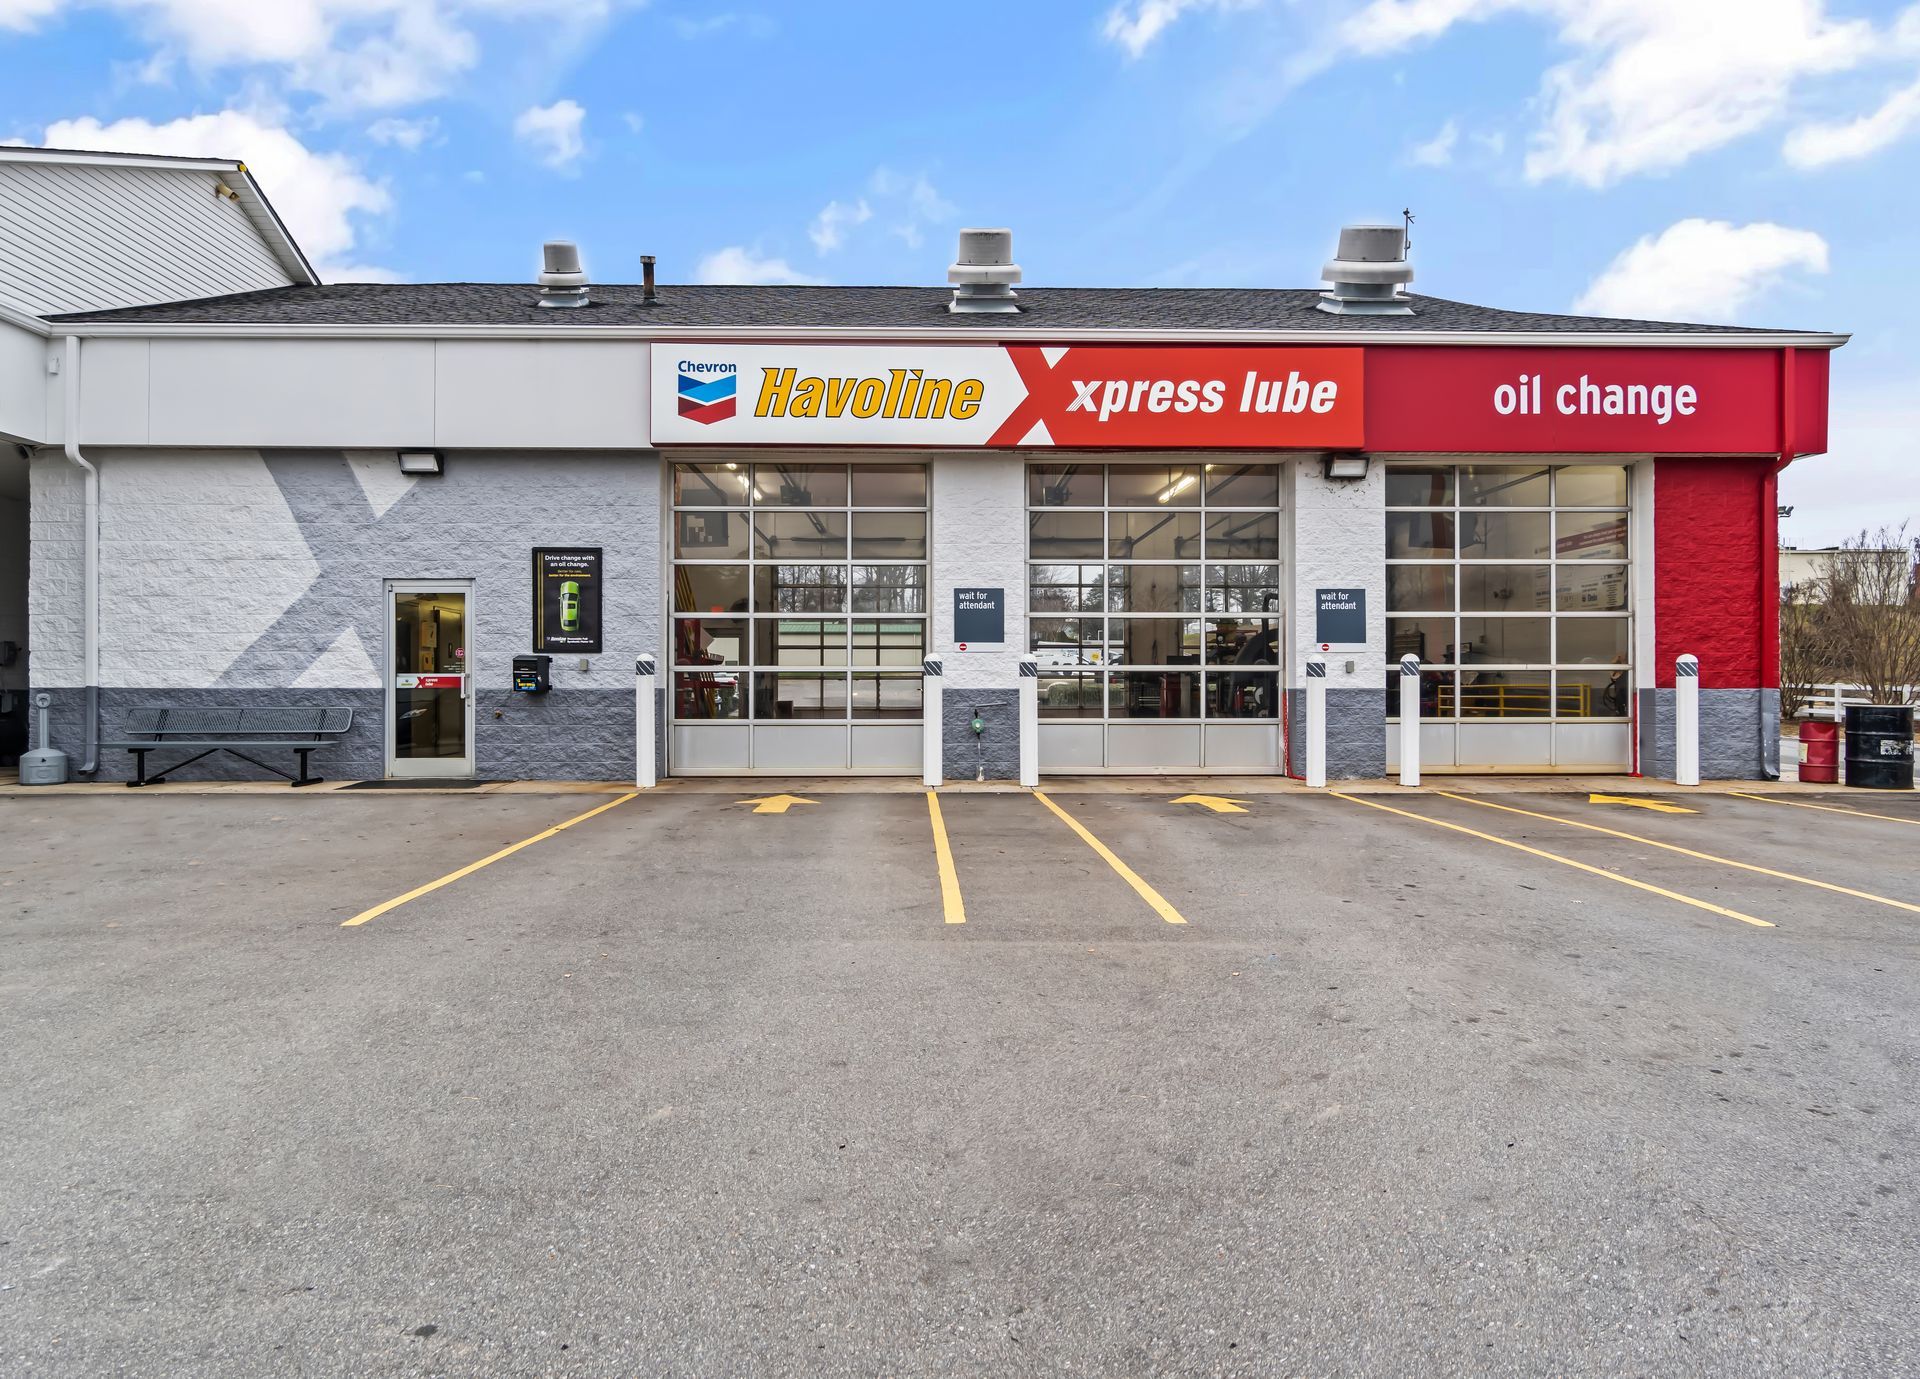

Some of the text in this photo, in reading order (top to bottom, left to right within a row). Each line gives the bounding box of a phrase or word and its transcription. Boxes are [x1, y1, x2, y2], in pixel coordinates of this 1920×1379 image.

[677, 360, 737, 373] Chevron
[754, 367, 1338, 422] Havoline xpress lube
[1493, 374, 1698, 425] oil change
[959, 591, 988, 600] wait for
[1320, 592, 1349, 600] wait for
[958, 601, 995, 610] attendant
[1320, 601, 1357, 610] attendant
